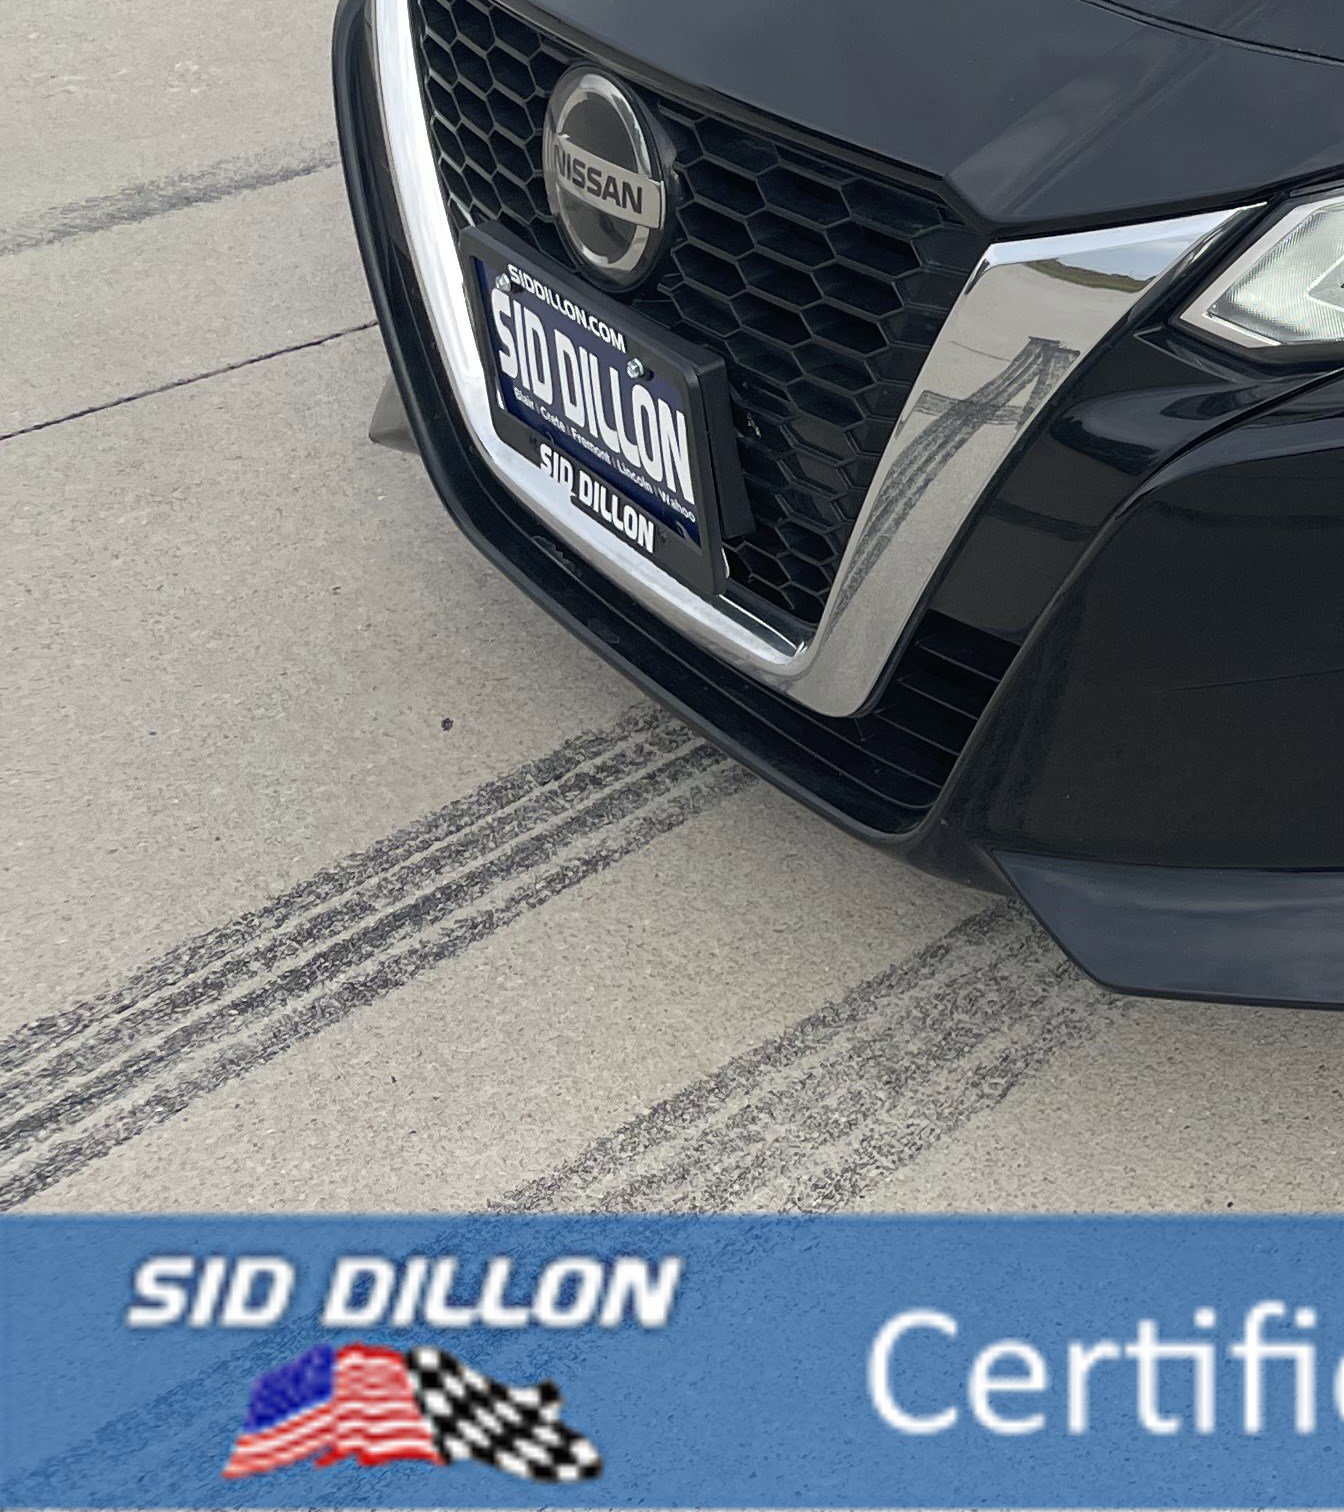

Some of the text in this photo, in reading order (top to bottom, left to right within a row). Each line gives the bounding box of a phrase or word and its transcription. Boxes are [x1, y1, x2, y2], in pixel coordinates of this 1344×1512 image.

[553, 143, 642, 215] NISSAN
[507, 263, 628, 354] SIDDILLON.COM
[491, 287, 696, 506] SID DILLON
[539, 443, 655, 554] SID DILLON
[540, 405, 566, 433] Crete
[571, 426, 611, 464] Fremont
[617, 458, 654, 494] Lincoln
[657, 487, 696, 523] Wahoo
